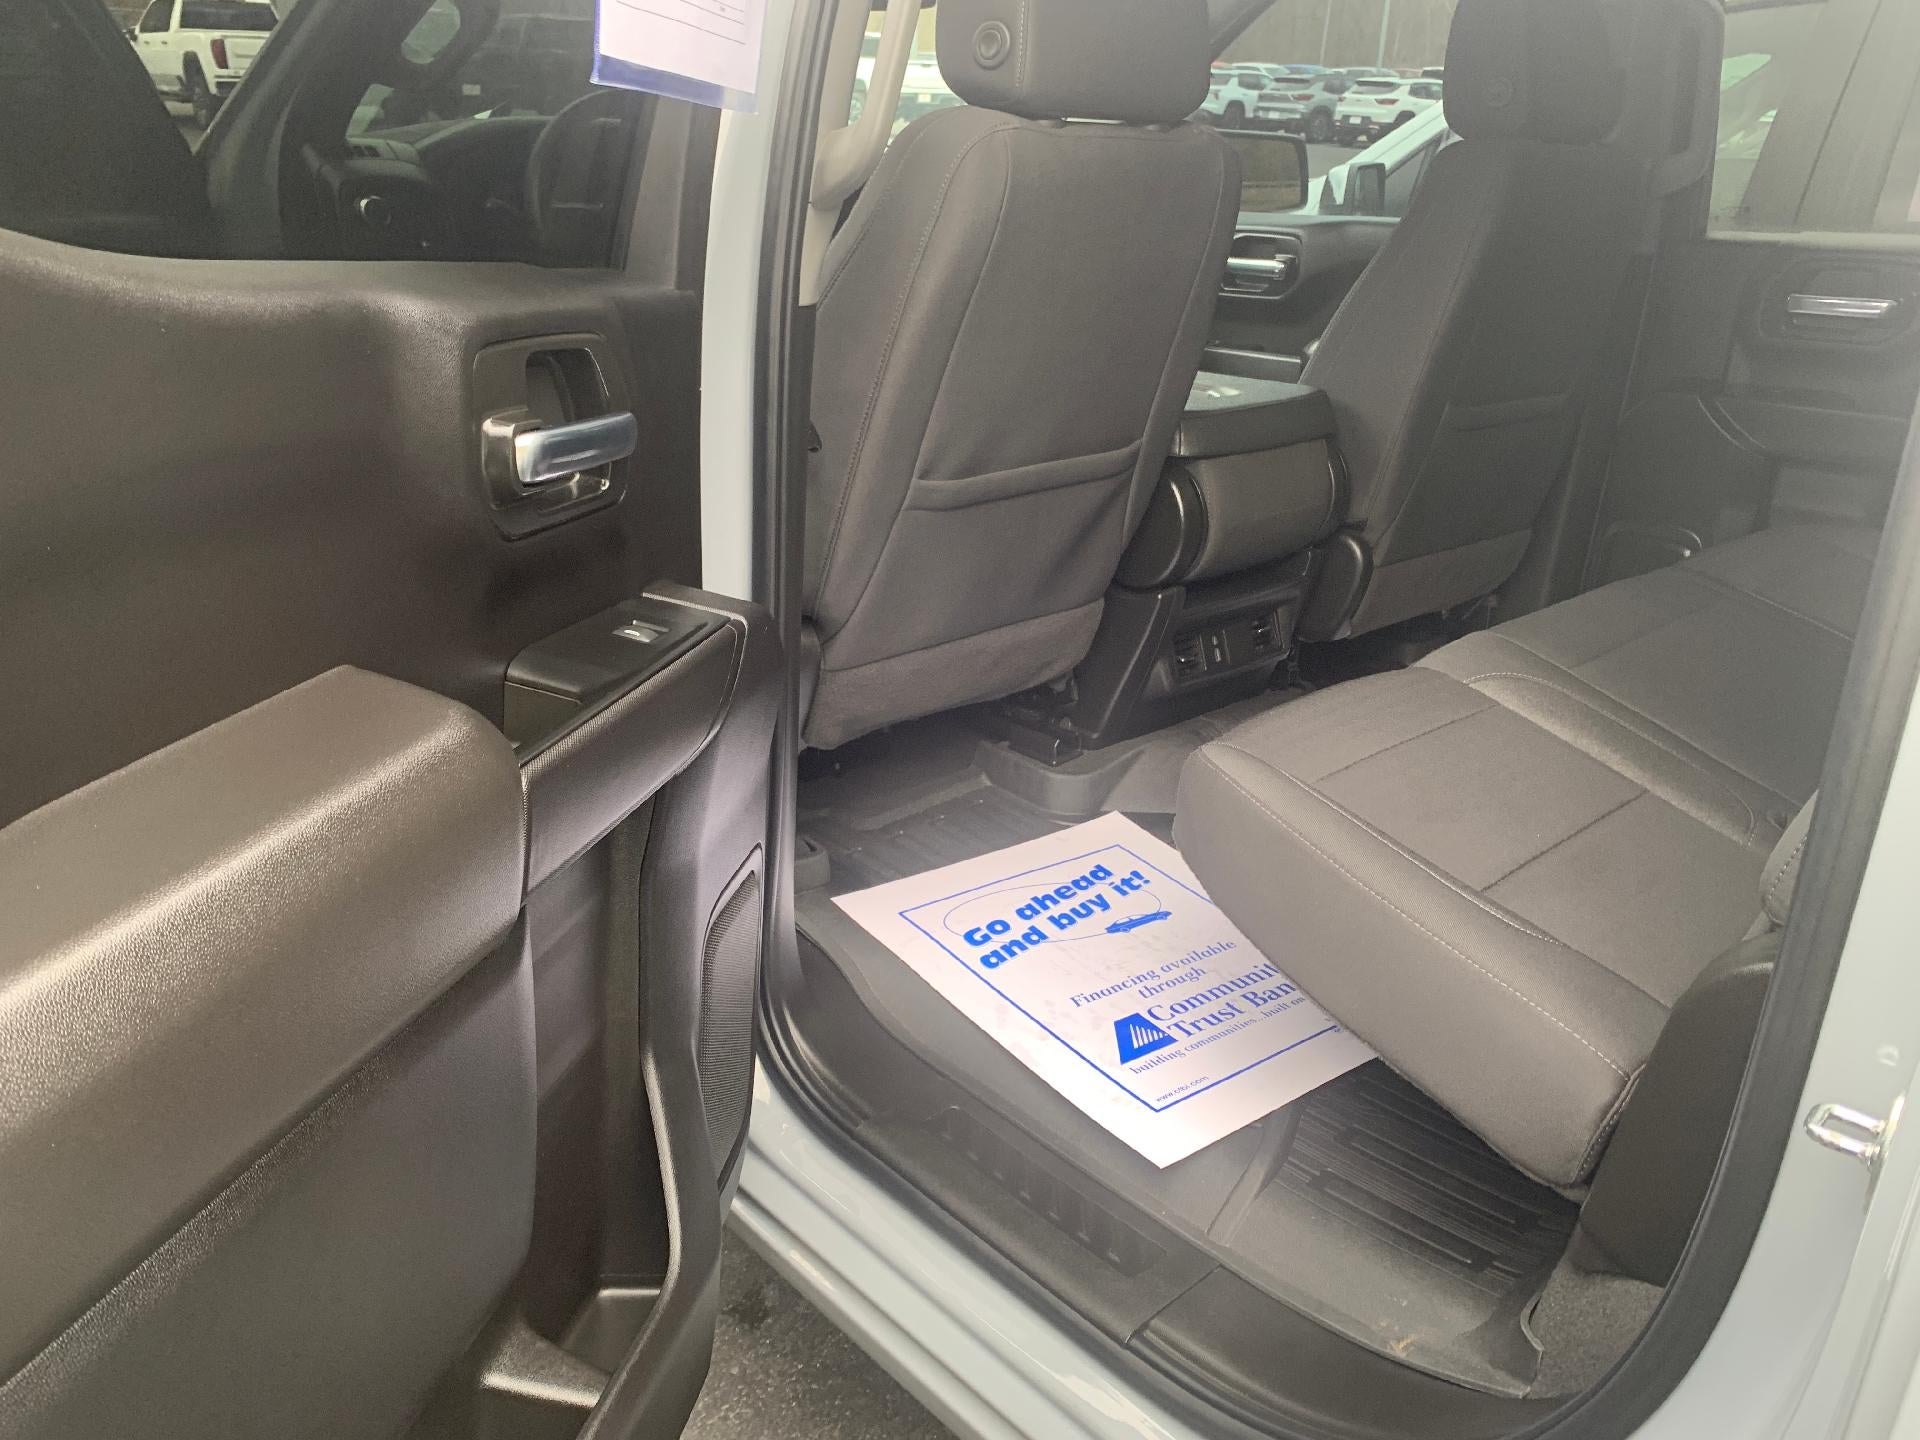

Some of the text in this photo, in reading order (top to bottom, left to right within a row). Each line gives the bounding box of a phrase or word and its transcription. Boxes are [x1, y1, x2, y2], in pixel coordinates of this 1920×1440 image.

[963, 863, 1113, 947] Go ahead
[979, 870, 1151, 969] and buy it!
[1069, 941, 1238, 1008] Financing available
[1138, 966, 1207, 999] through
[1146, 962, 1281, 1022] Communit
[1166, 983, 1297, 1039] Trust Ban
[1129, 1048, 1187, 1075] building
